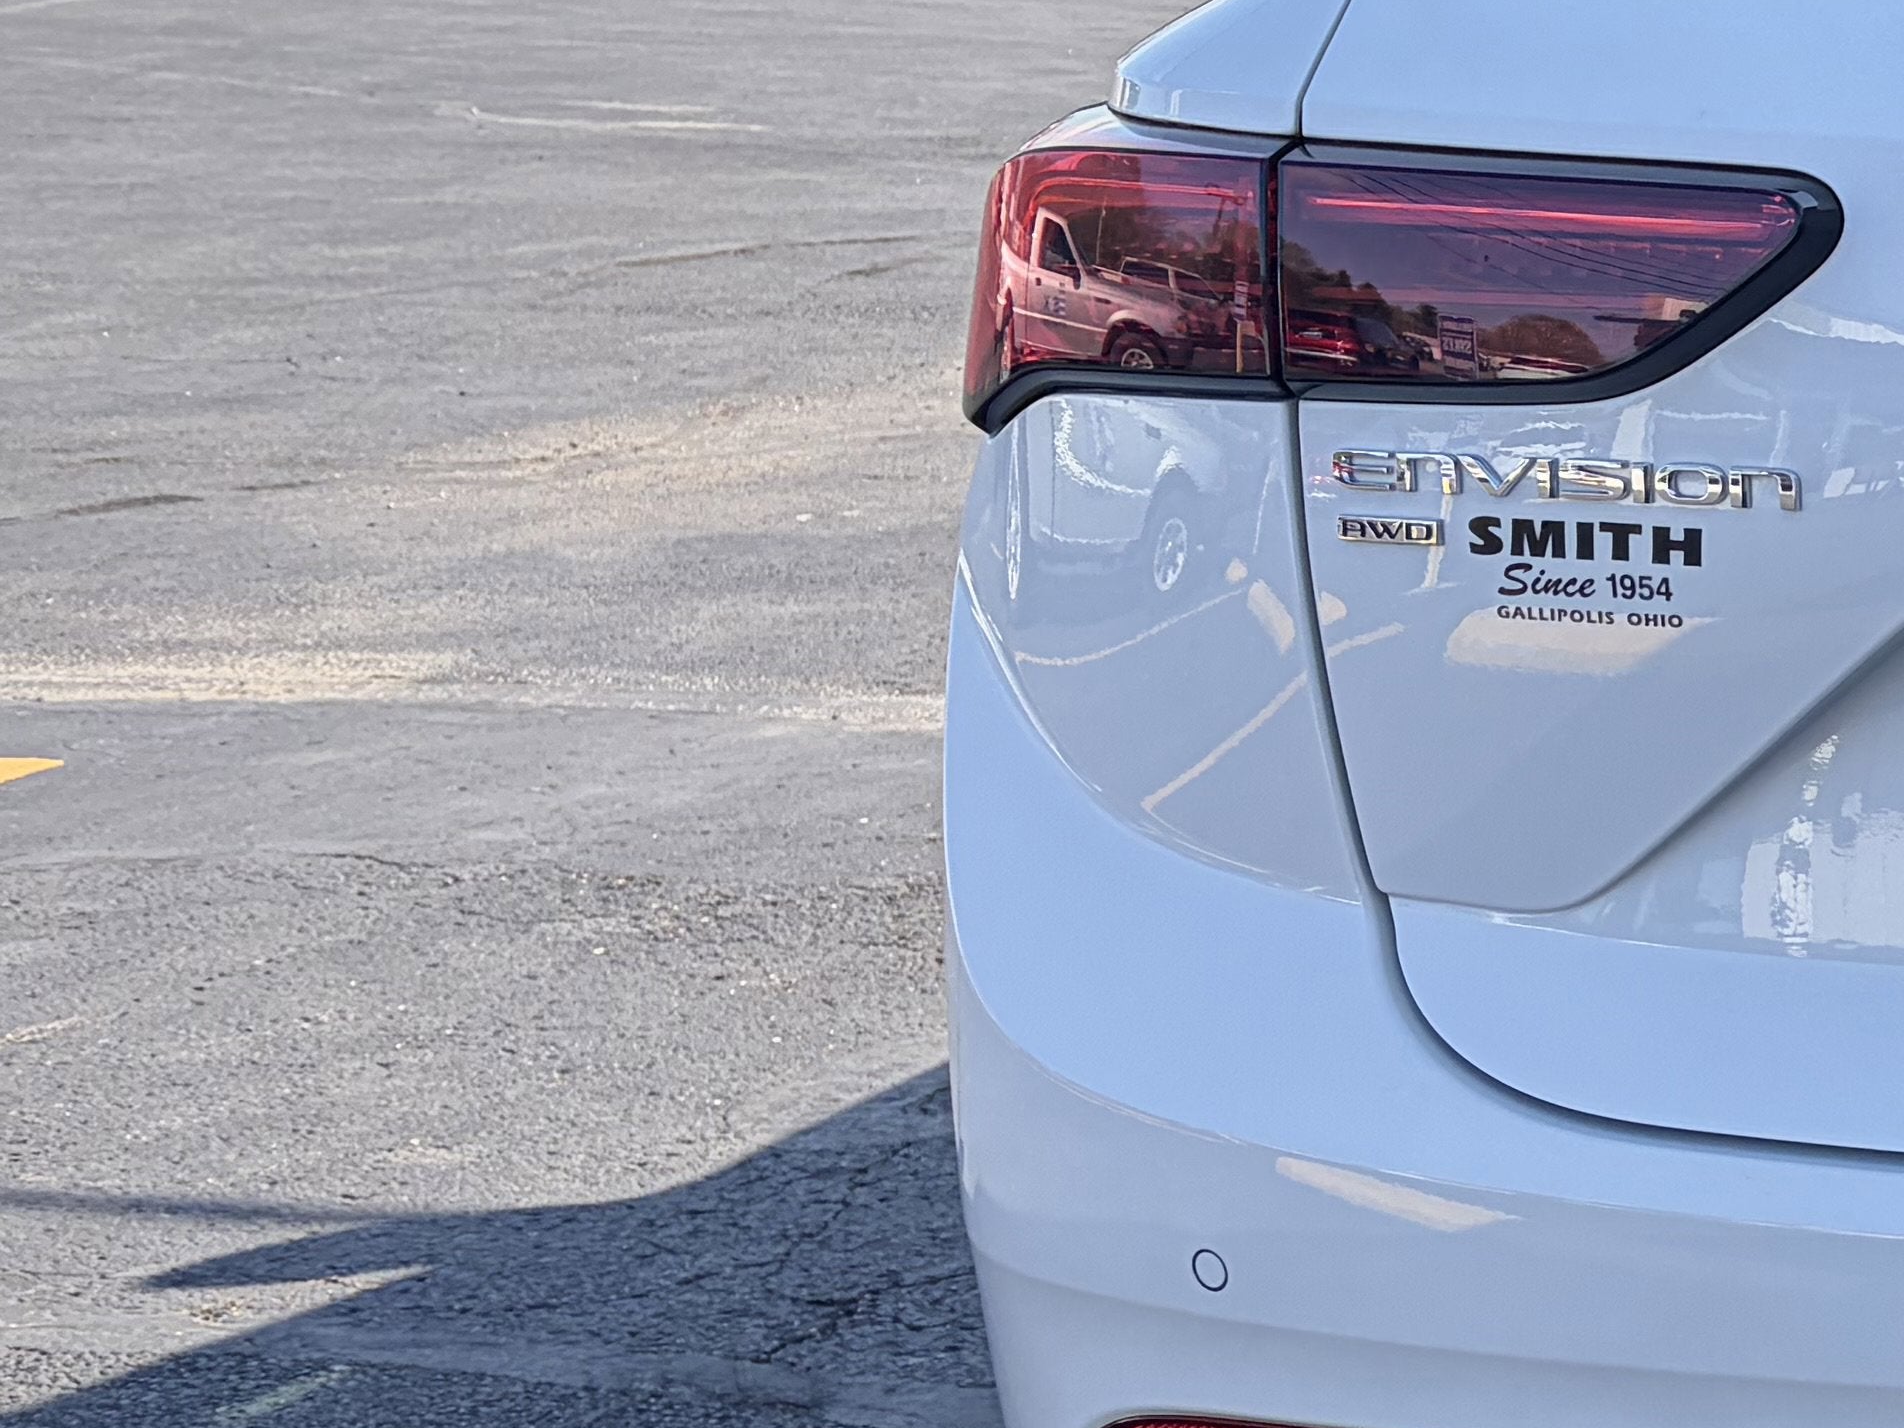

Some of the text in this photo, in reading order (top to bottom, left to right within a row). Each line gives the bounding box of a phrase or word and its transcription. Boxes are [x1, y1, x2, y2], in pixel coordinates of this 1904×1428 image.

[1340, 517, 1436, 543] AWD
[1468, 515, 1703, 568] SMITH
[1497, 562, 1673, 602] Since 1954
[1496, 604, 1683, 629] GALLIPOLIS OHIO
